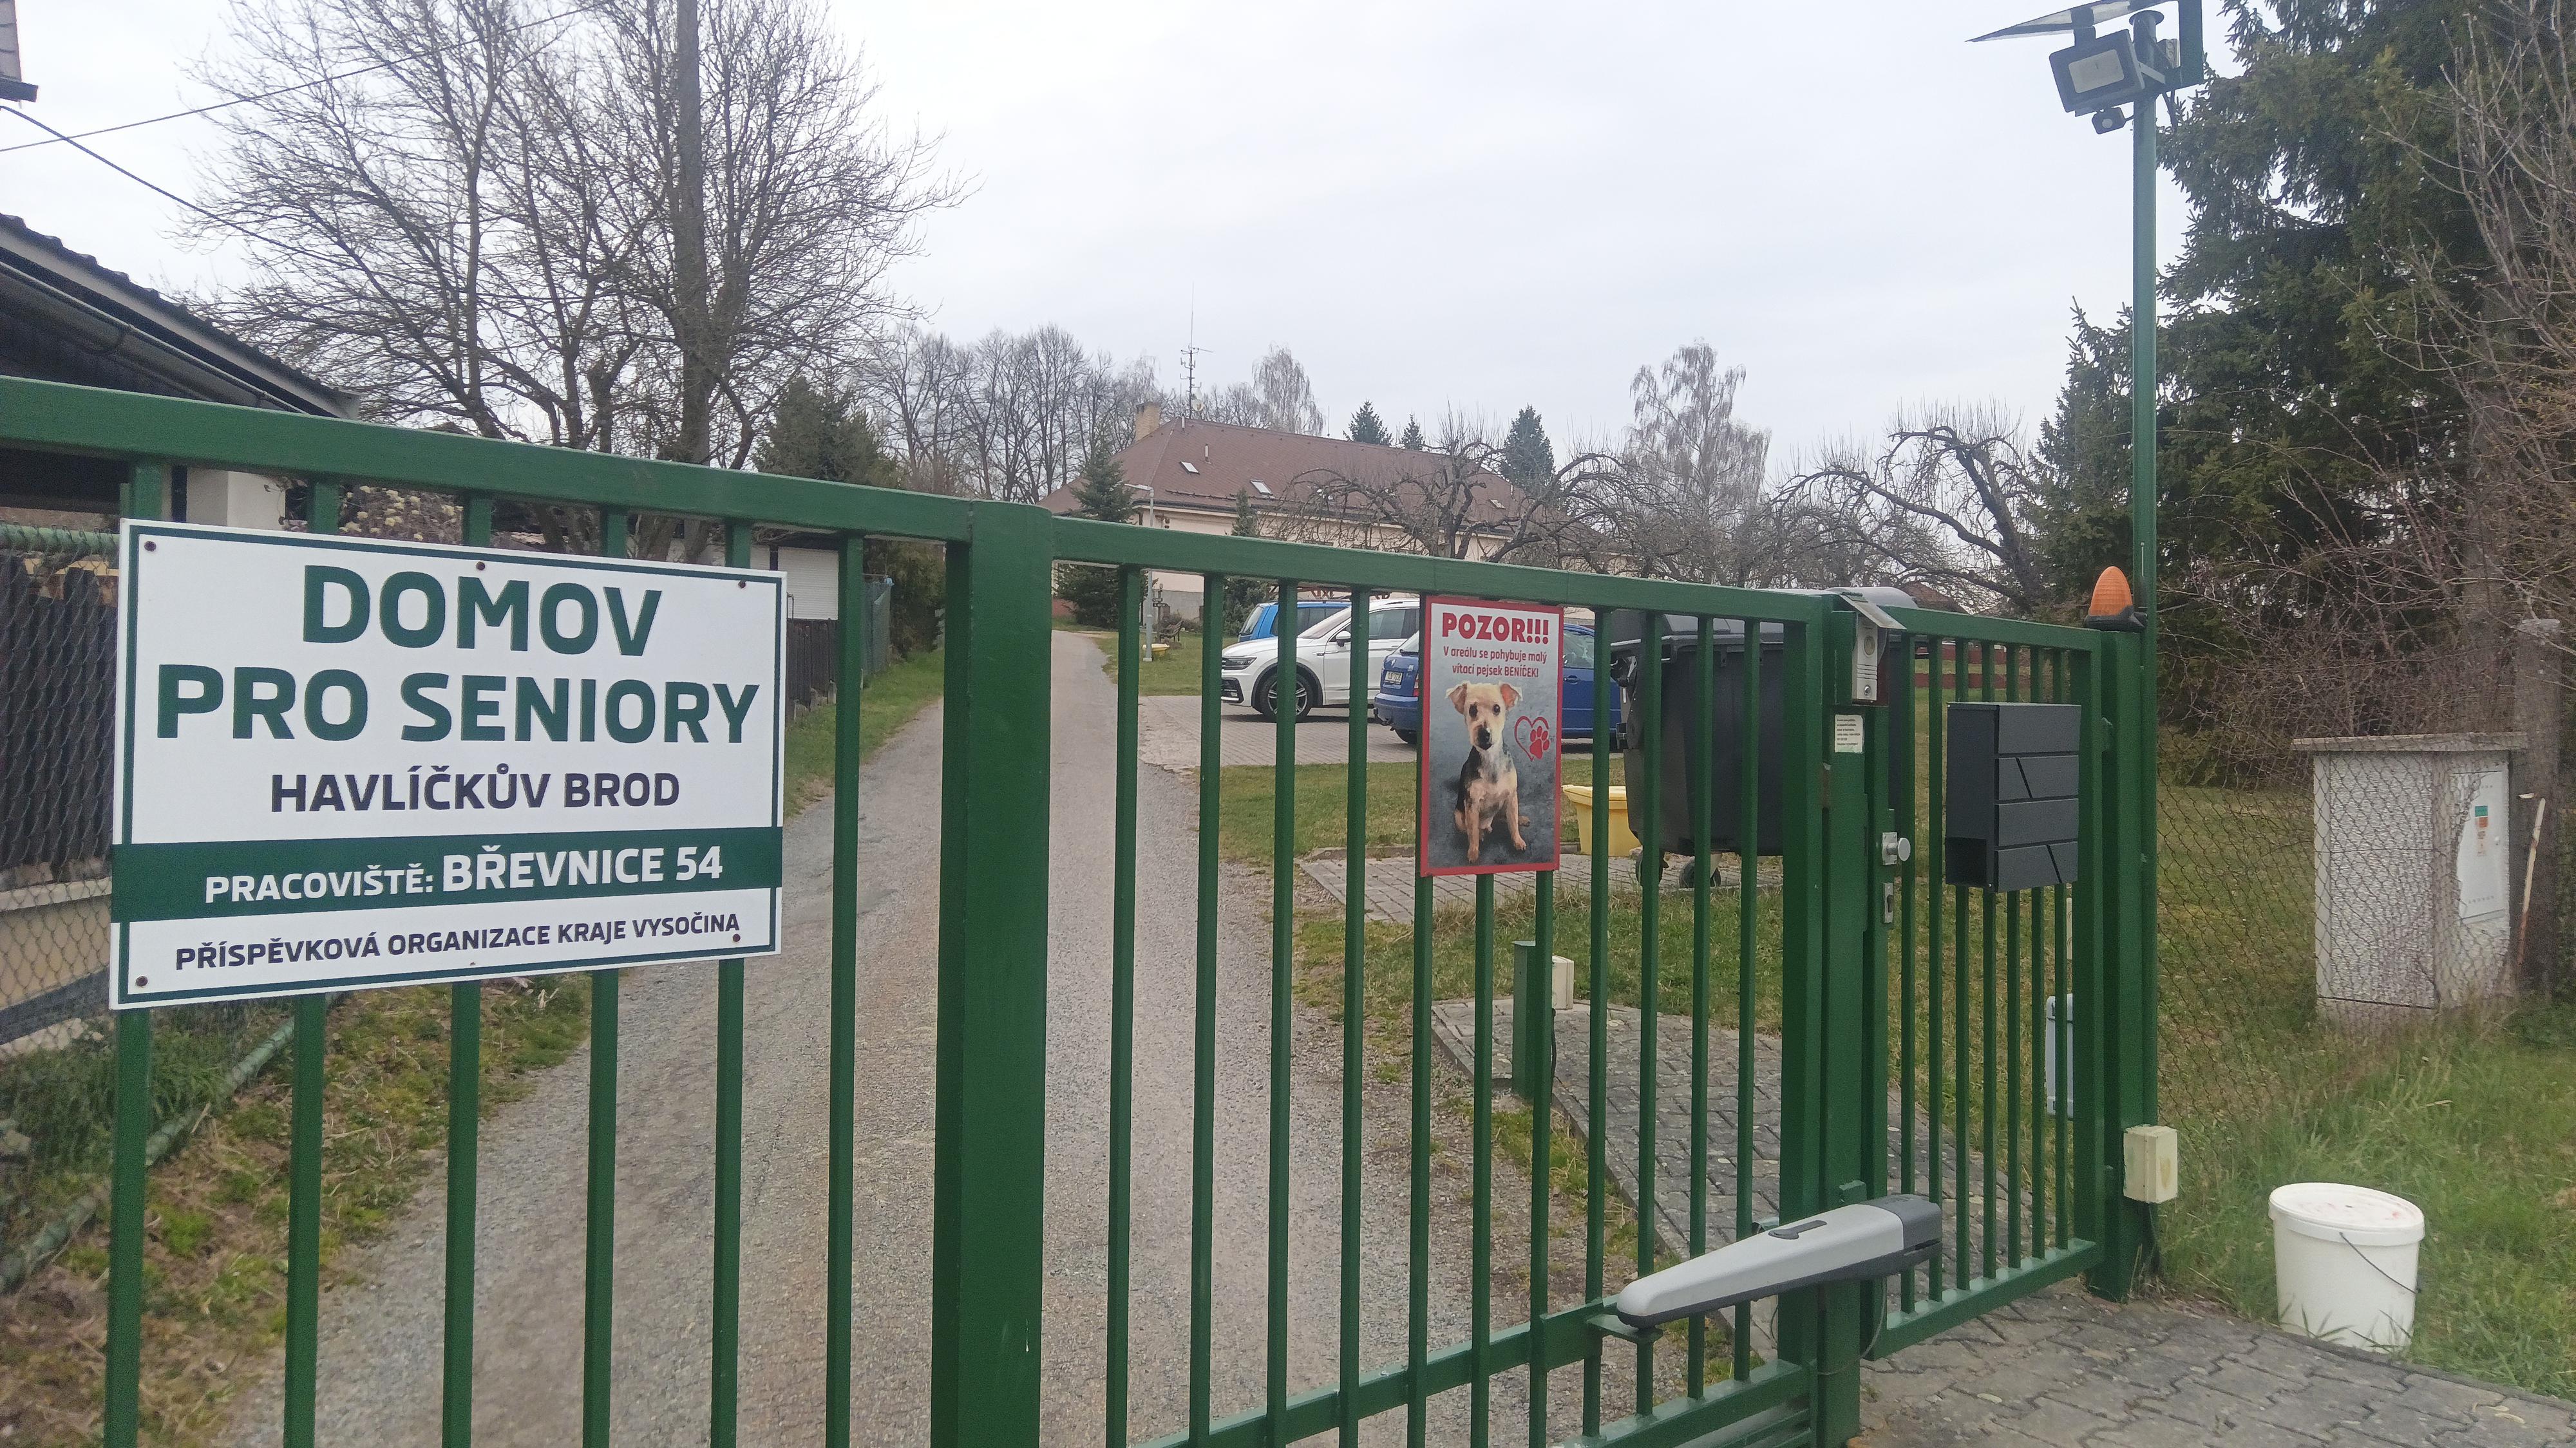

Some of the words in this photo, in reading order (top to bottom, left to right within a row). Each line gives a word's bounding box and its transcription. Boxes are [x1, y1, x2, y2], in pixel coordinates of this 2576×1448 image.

[303, 565, 662, 656] DOMOV
[1442, 612, 1549, 644] POZOR!!!
[1443, 646, 1449, 656] V
[1451, 646, 1477, 658] areálu
[1479, 650, 1488, 659] se
[1490, 649, 1526, 663] pohybuje
[1528, 650, 1547, 664] malý
[1452, 663, 1475, 674] vítací
[1477, 664, 1502, 677] pejsek
[157, 664, 368, 742] PRO
[400, 672, 760, 744] SENIORY
[271, 764, 551, 812] HAVLÍČKŮV
[564, 772, 679, 808] BROD
[205, 863, 433, 903] PRACOVIŠTĚ:
[442, 845, 665, 892] BŘEVNICE
[676, 845, 723, 881] 54
[176, 931, 381, 970] PŘÍSPĚVKOVÁ
[388, 925, 551, 955] ORGANIZACE
[558, 920, 627, 945] KRAJE
[632, 912, 740, 938] VYSOČINA
